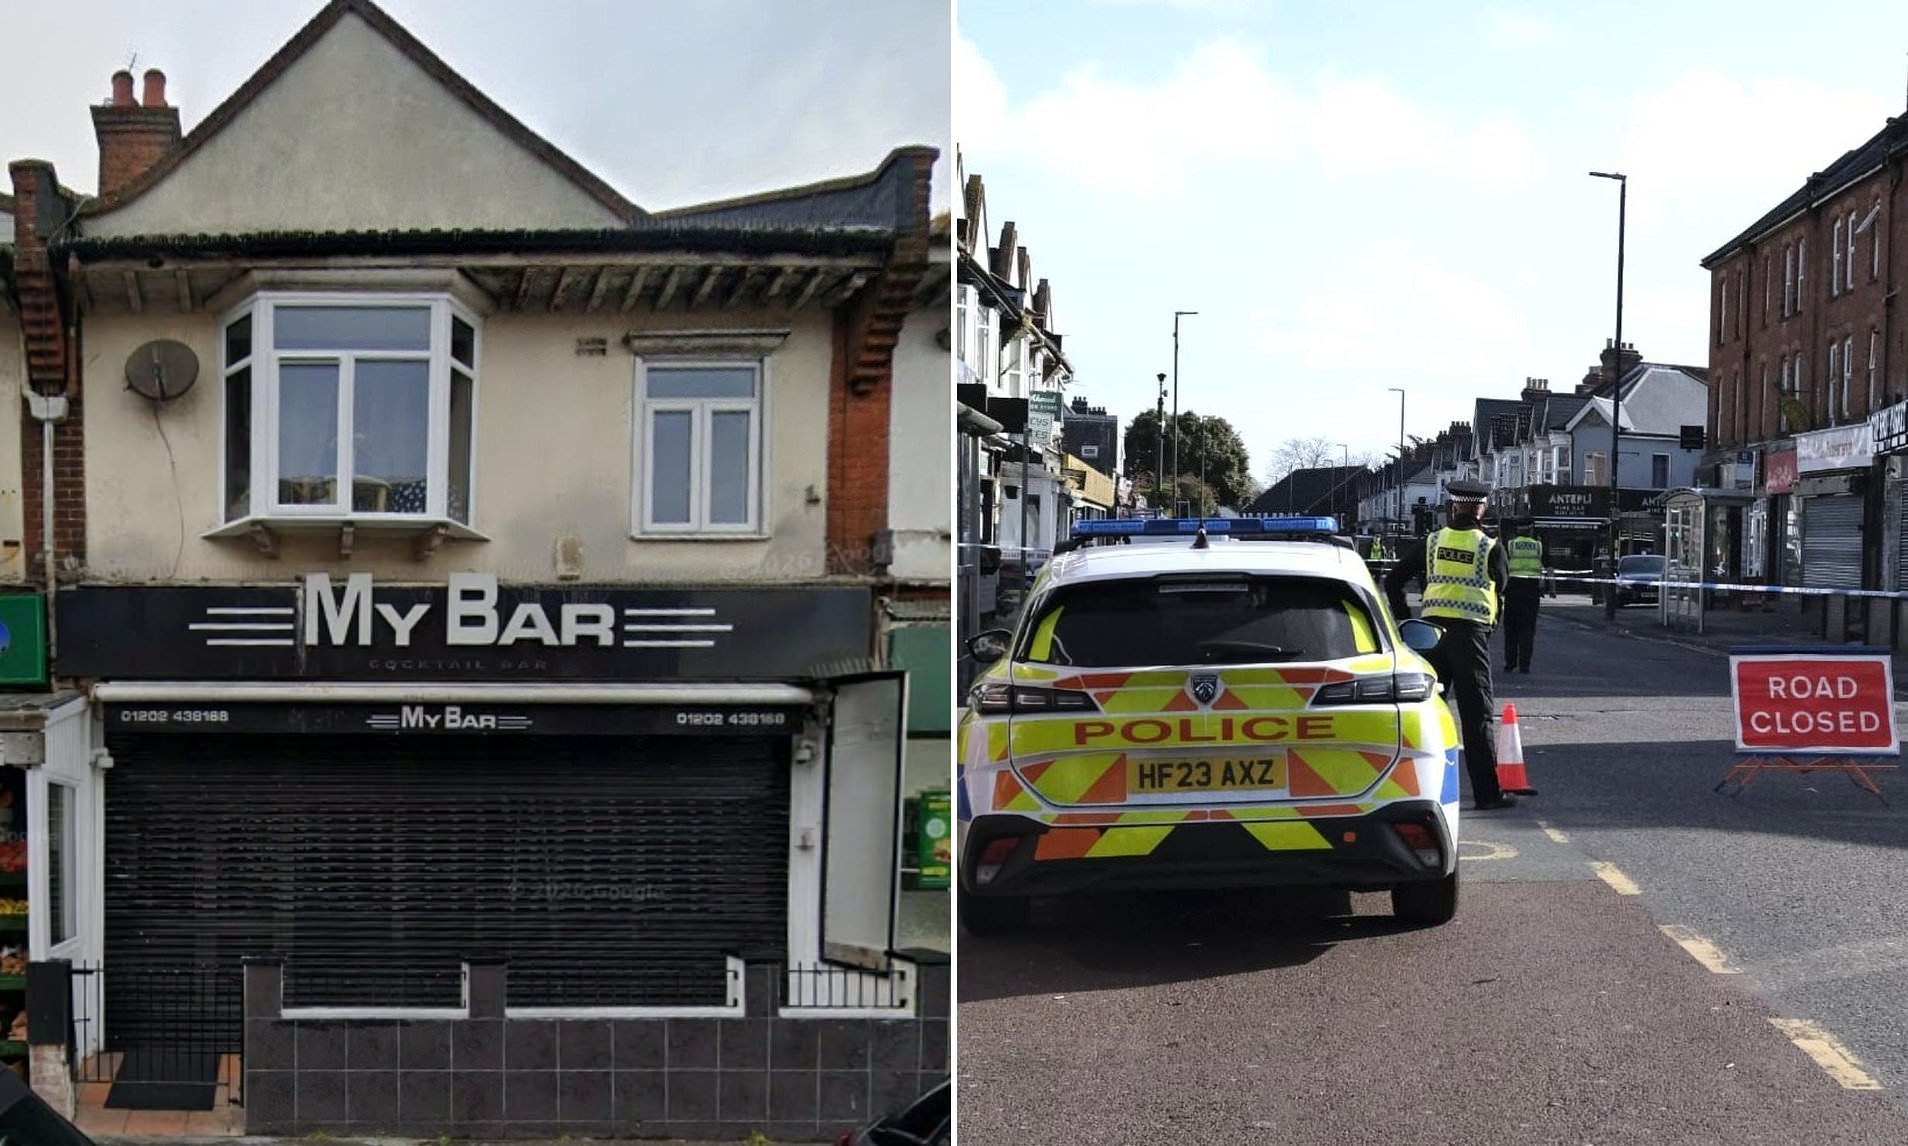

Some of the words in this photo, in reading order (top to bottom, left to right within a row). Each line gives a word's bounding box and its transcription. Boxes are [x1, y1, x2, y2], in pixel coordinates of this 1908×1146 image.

[1439, 548, 1473, 563] POLICE
[369, 659, 486, 671] COCKTAIL
[501, 659, 548, 670] BAR
[1768, 676, 1858, 699] ROAD
[121, 710, 168, 722] 01202
[677, 713, 724, 726] 01202
[1750, 711, 1880, 733] CLOSED
[1074, 716, 1336, 745] POLICE
[1138, 762, 1211, 789] HF23
[1222, 759, 1274, 786] AXZ
